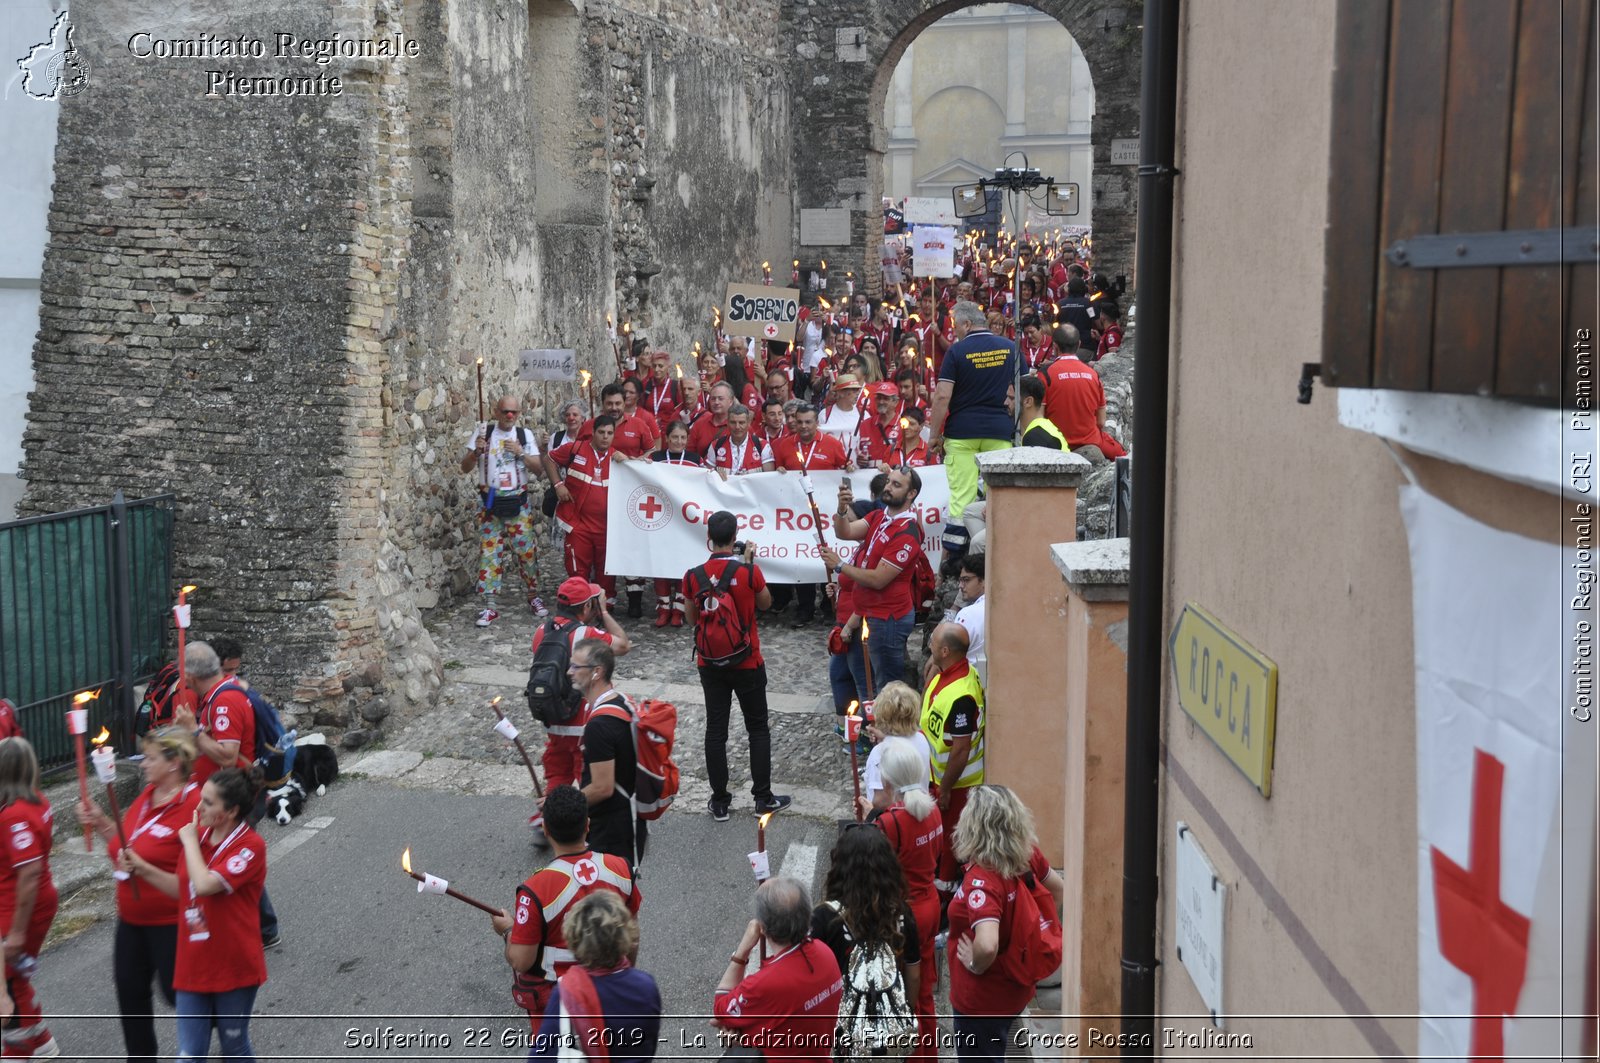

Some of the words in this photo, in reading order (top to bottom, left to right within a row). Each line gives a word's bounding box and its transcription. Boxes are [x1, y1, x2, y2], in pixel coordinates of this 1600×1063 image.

[1113, 152, 1139, 160] CASTEL
[729, 294, 797, 323] SORBOLO
[532, 359, 561, 370] PARMA
[681, 501, 765, 531] Crce
[775, 508, 837, 531] Ros
[1189, 635, 1252, 750] ROCCA
